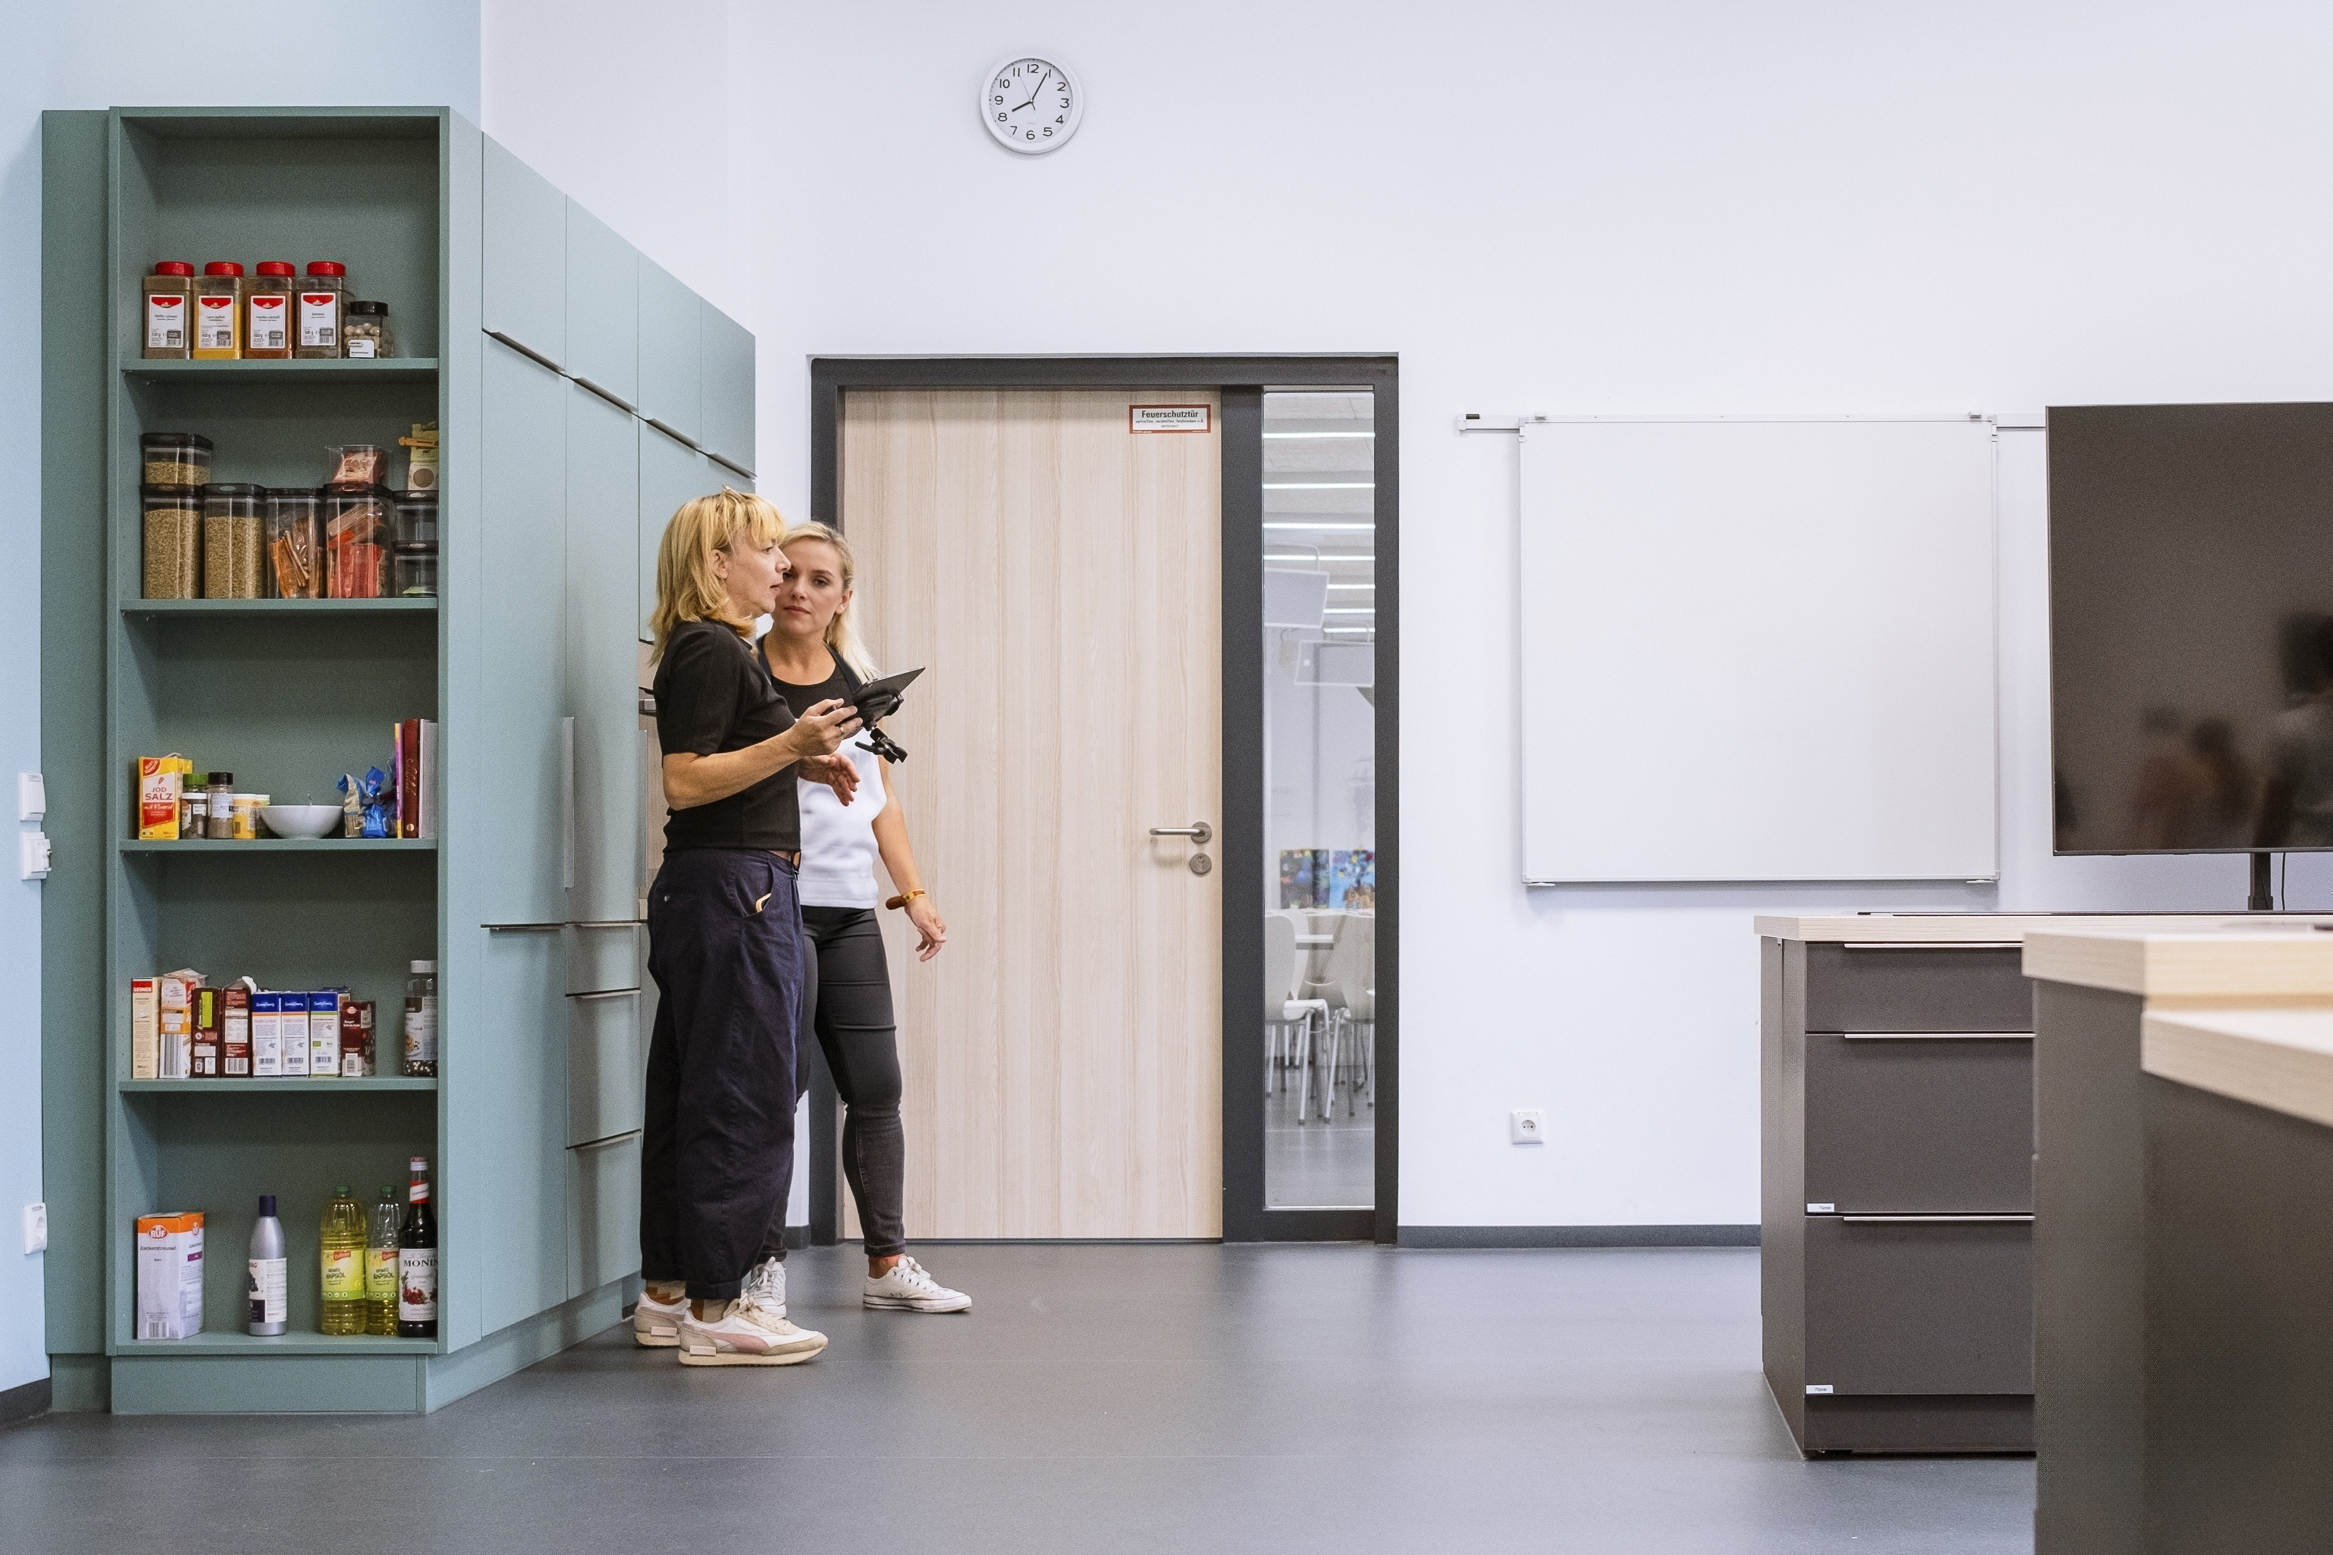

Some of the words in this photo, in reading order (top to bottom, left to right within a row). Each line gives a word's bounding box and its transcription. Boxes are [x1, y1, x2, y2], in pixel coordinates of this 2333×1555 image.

[1013, 67, 1020, 77] 11
[1026, 64, 1039, 73] 12
[1048, 69, 1052, 78] 1
[999, 79, 1010, 88] 10
[1057, 82, 1066, 91] 2
[994, 95, 1004, 105] 9
[1060, 98, 1070, 108] 3
[997, 112, 1008, 122] 8
[1055, 115, 1064, 124] 4
[1010, 125, 1018, 135] 7
[1026, 130, 1036, 140] 6
[1043, 127, 1053, 137] 5
[1141, 410, 1199, 418] Feuerschutztür
